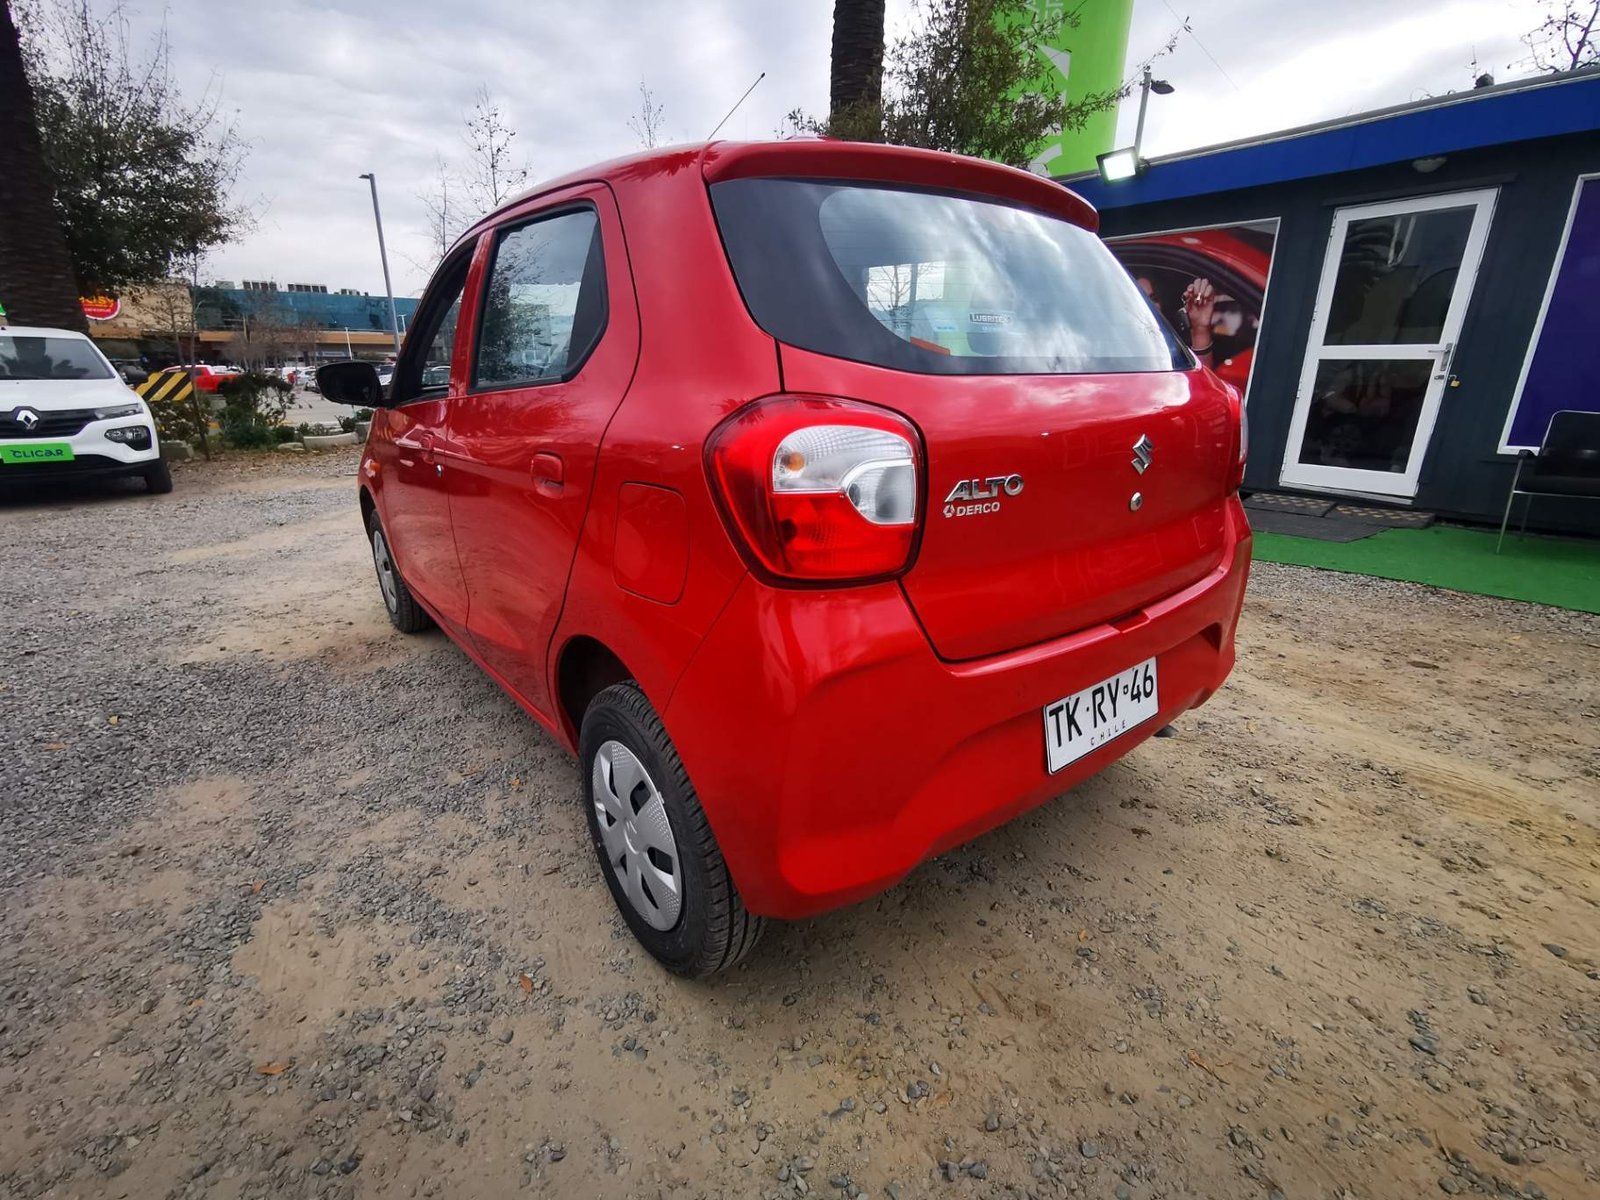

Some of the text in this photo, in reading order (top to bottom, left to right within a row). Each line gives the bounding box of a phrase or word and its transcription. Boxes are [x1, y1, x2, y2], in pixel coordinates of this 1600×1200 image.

[944, 473, 1025, 503] ALTO
[956, 501, 1001, 517] DERCO
[1090, 719, 1127, 746] CHILE
